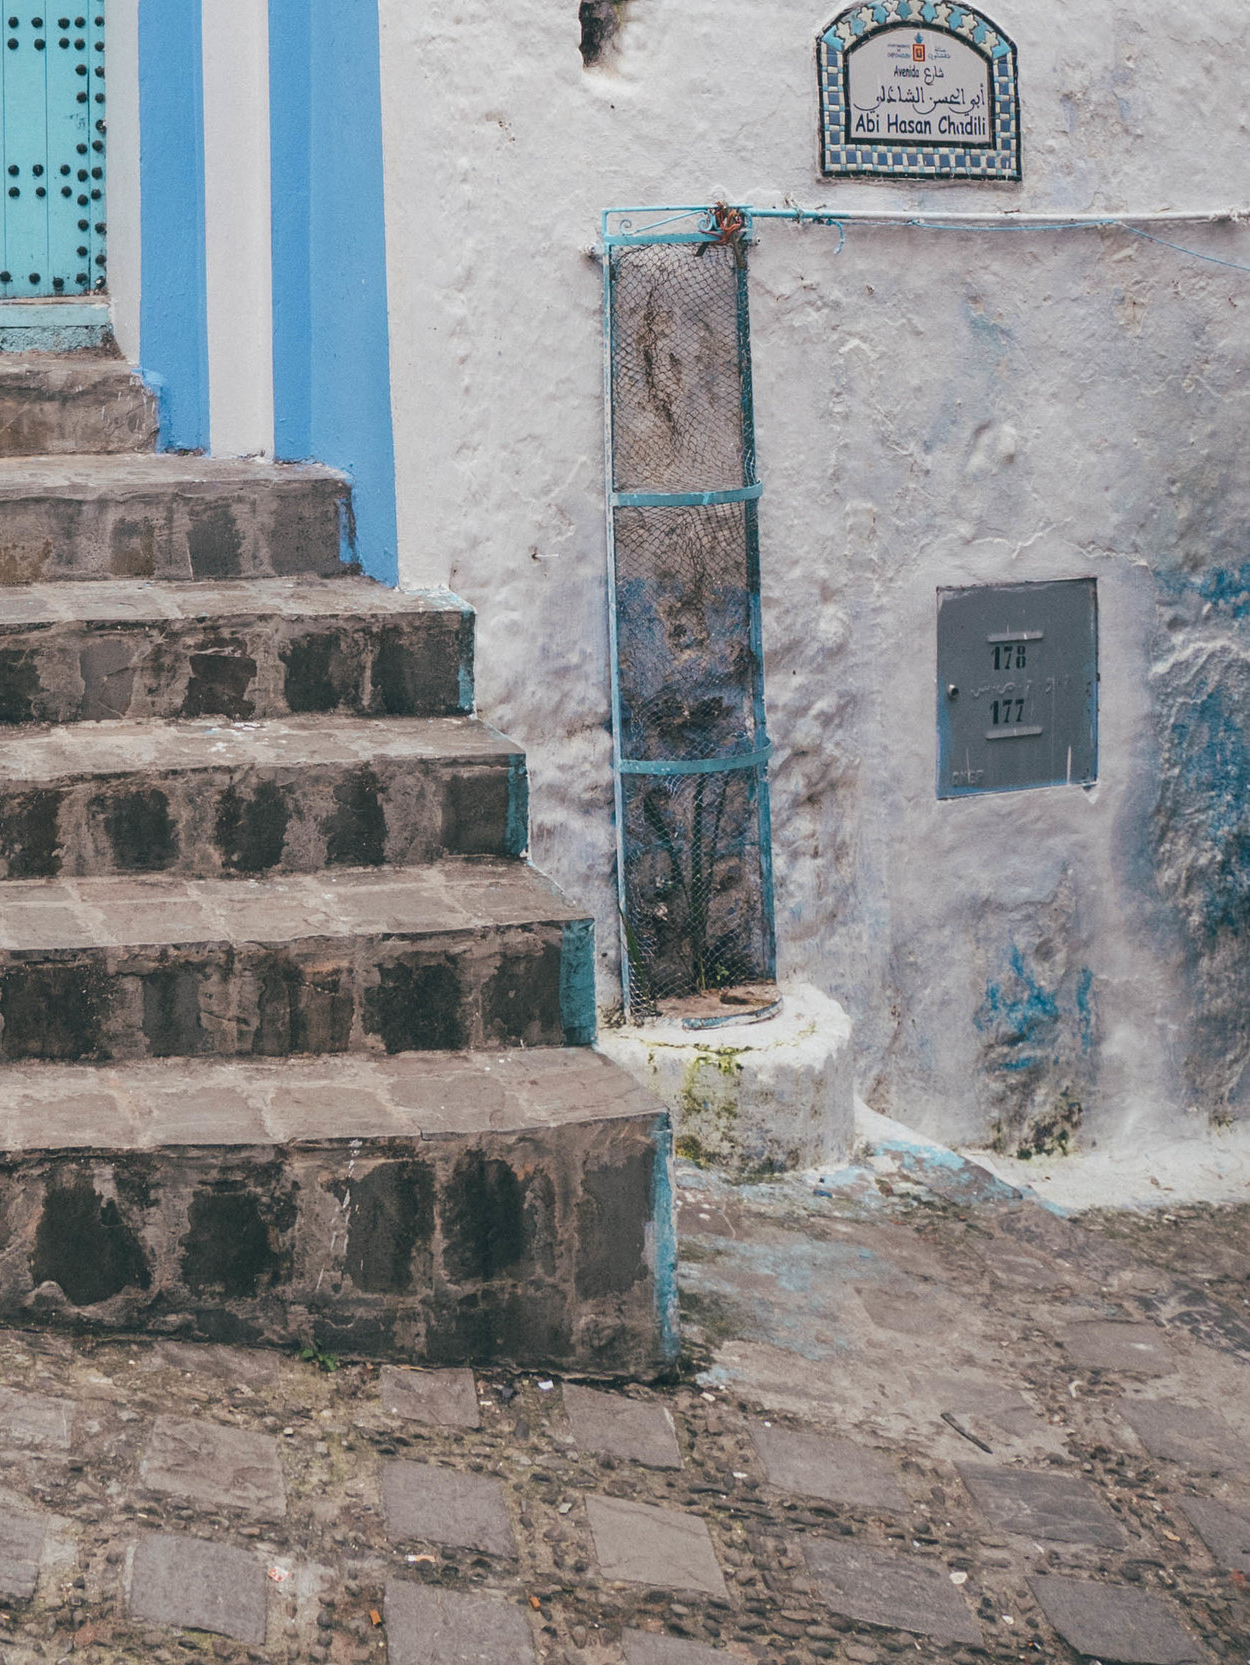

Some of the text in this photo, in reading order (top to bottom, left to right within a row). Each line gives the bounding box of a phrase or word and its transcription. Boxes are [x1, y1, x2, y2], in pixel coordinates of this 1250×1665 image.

[893, 65, 920, 78] Avenida
[923, 65, 945, 86] شارع
[853, 82, 986, 117] أبي الحسن الشاذلي
[855, 113, 880, 133] Abi
[887, 113, 932, 135] Hasan
[990, 645, 1027, 670] 178
[989, 698, 1025, 725] 177
